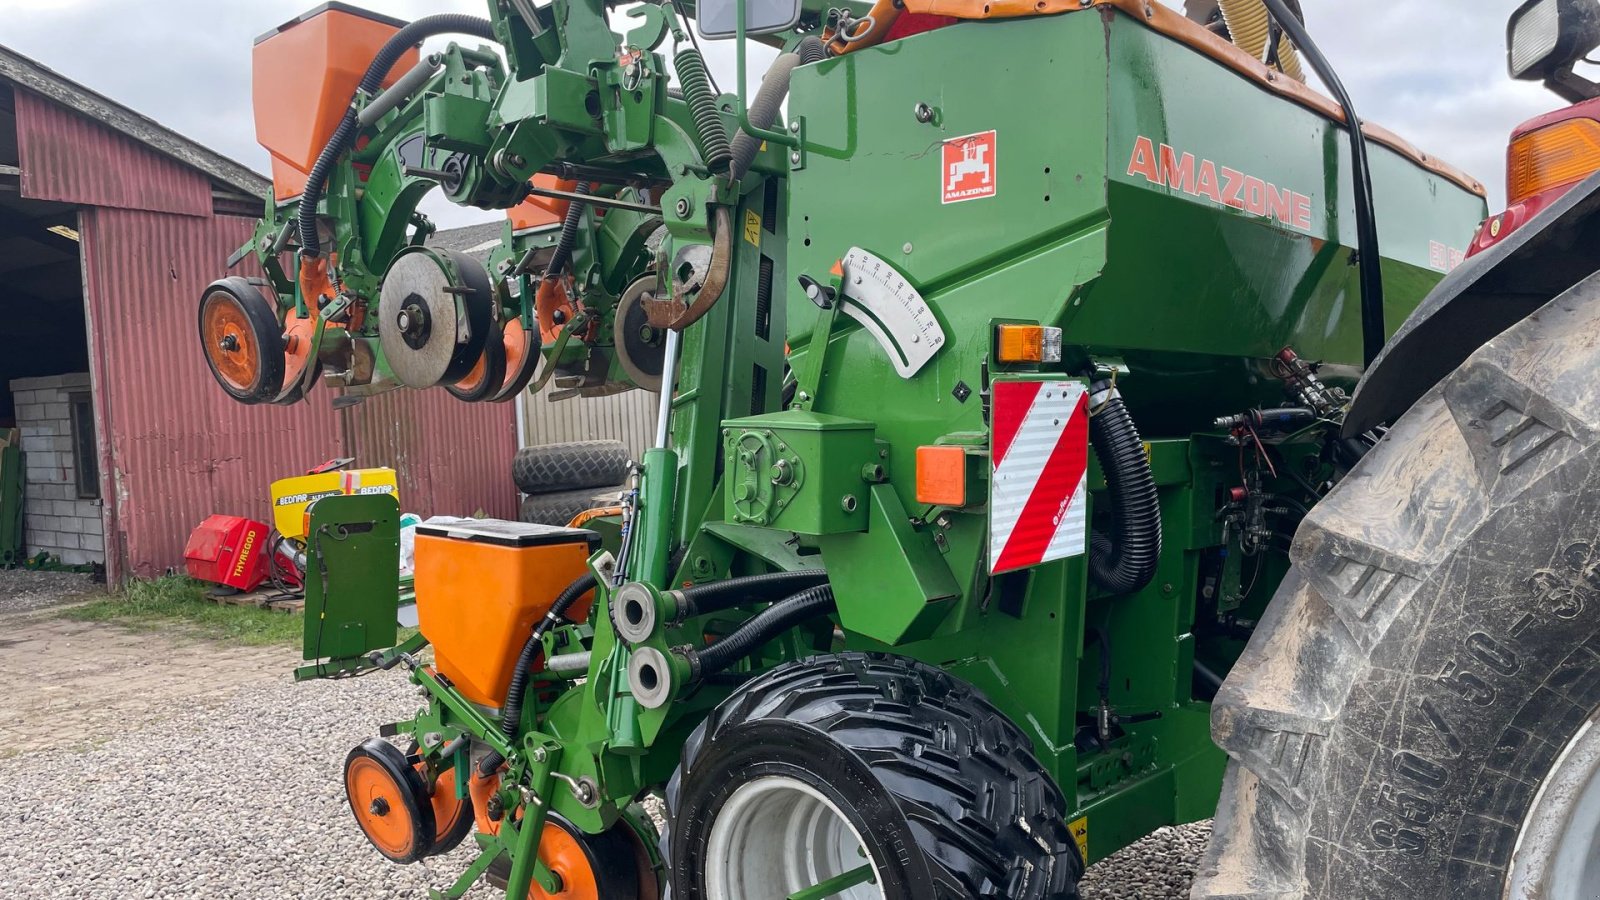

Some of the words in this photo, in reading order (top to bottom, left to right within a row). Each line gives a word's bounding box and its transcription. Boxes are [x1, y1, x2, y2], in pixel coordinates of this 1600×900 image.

[945, 186, 993, 199] AMAZONE
[1126, 135, 1311, 231] AMAZONE
[862, 256, 869, 264] 10
[874, 263, 881, 271] 20
[886, 272, 893, 280] 30
[897, 282, 904, 290] 40
[908, 293, 915, 302] 50
[918, 306, 925, 315] 60
[926, 321, 934, 329] 70
[934, 336, 942, 345] 80
[280, 493, 308, 506] BEDNAR
[361, 484, 393, 495] BEDNAR
[233, 530, 256, 577] THYREGOD
